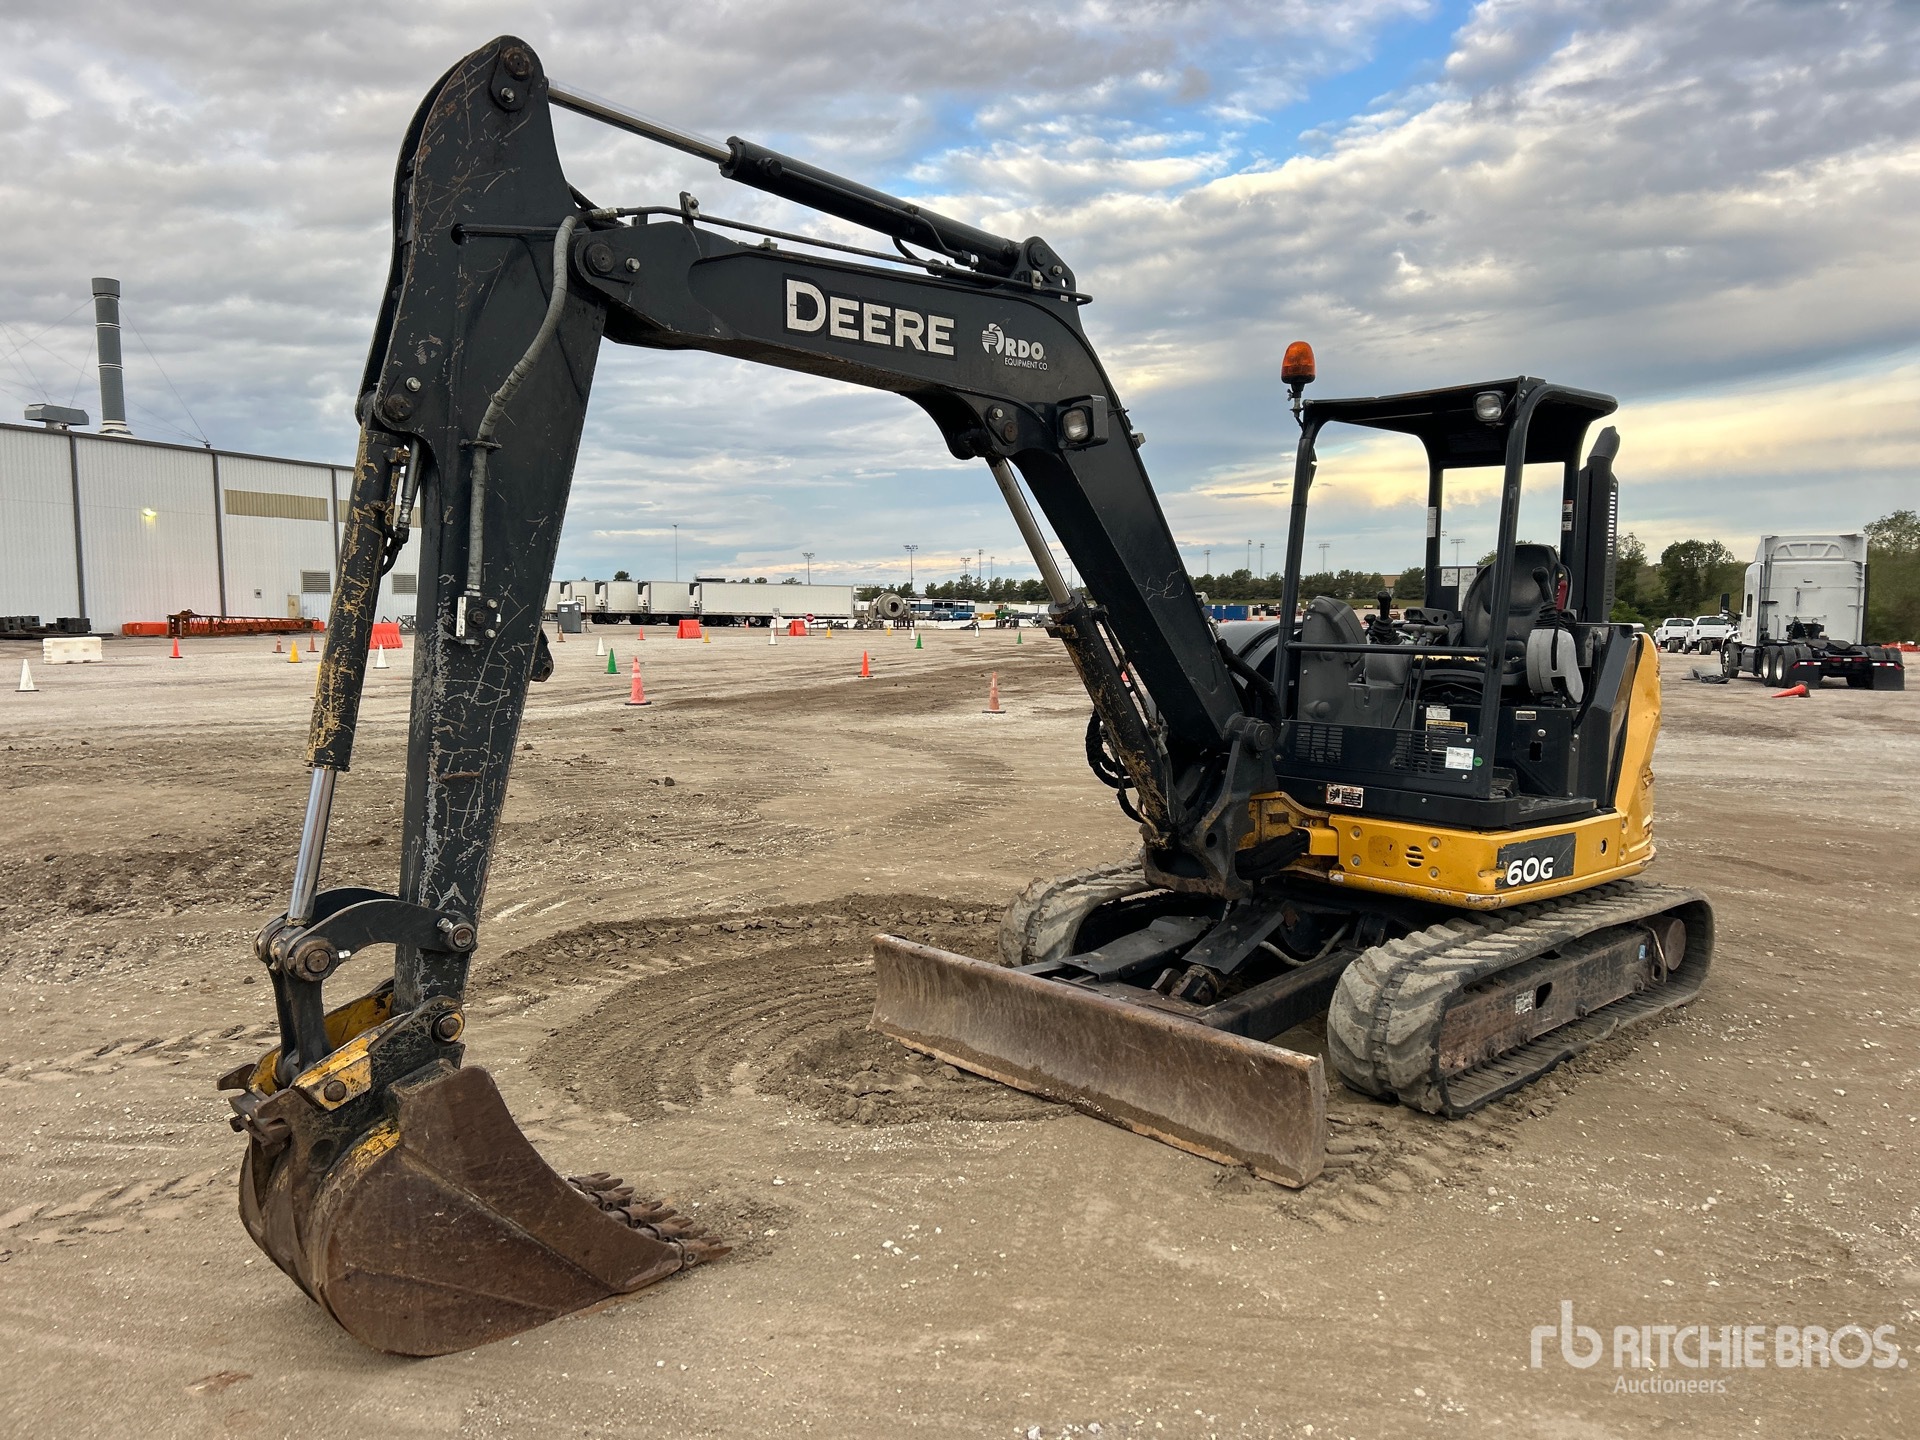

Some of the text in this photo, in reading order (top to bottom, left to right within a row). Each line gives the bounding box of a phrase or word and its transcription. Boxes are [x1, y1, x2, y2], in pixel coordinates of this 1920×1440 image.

[786, 278, 955, 356] DEERE
[1004, 357, 1038, 369] EQUIPMENT
[1506, 857, 1554, 886] 60G
